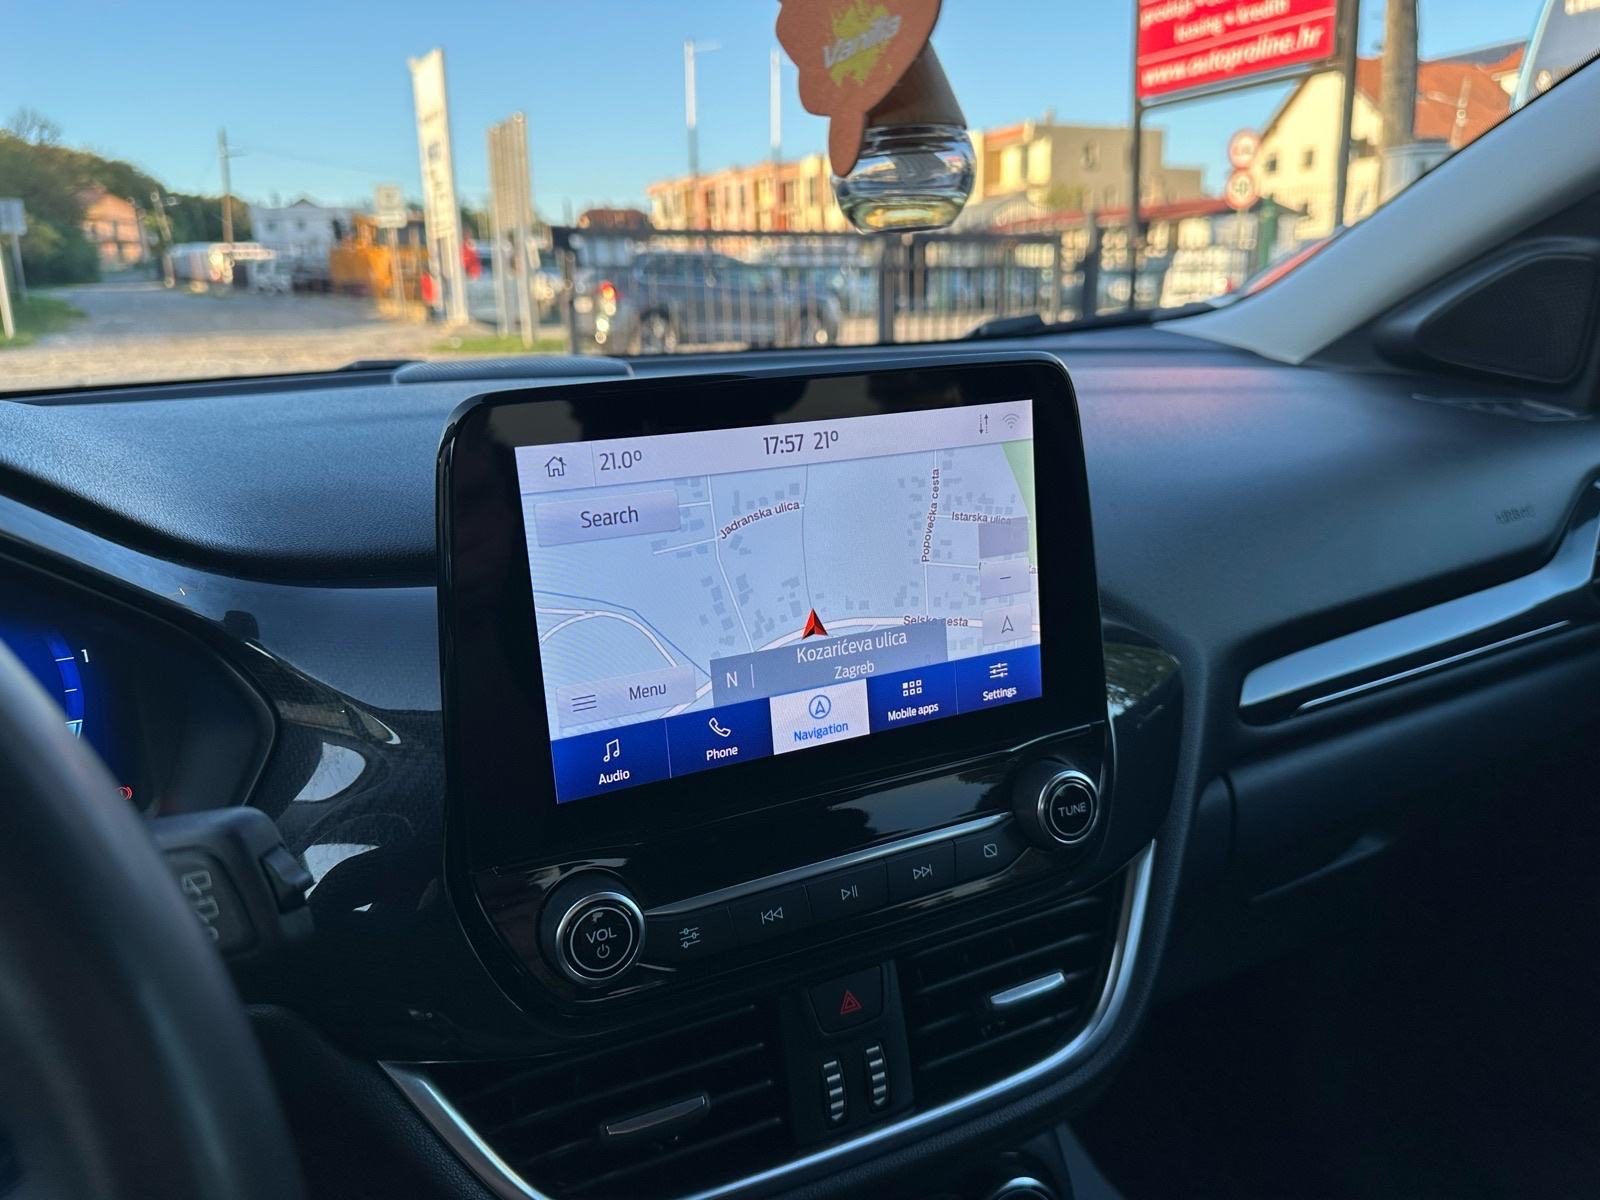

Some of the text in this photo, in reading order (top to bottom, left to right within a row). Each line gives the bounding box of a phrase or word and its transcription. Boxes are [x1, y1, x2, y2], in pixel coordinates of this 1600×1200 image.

[763, 433, 804, 455] 17:57
[580, 506, 639, 529] Search
[720, 501, 800, 539] Jadranska ulica
[921, 468, 940, 562] Popovečka cesta
[952, 511, 988, 522] Istarska
[944, 616, 969, 627] esta
[796, 631, 907, 664] Kozarićeva ulica
[725, 671, 739, 688] N
[834, 661, 875, 680] Zagreb
[629, 683, 667, 701] Menu
[983, 686, 1017, 702] Settings
[887, 703, 939, 722] Mobile apps
[794, 722, 849, 742] Navigation
[706, 745, 739, 761] Phone
[598, 768, 630, 785] Audio
[1058, 802, 1087, 817] TUNE
[585, 927, 617, 944] VOL
